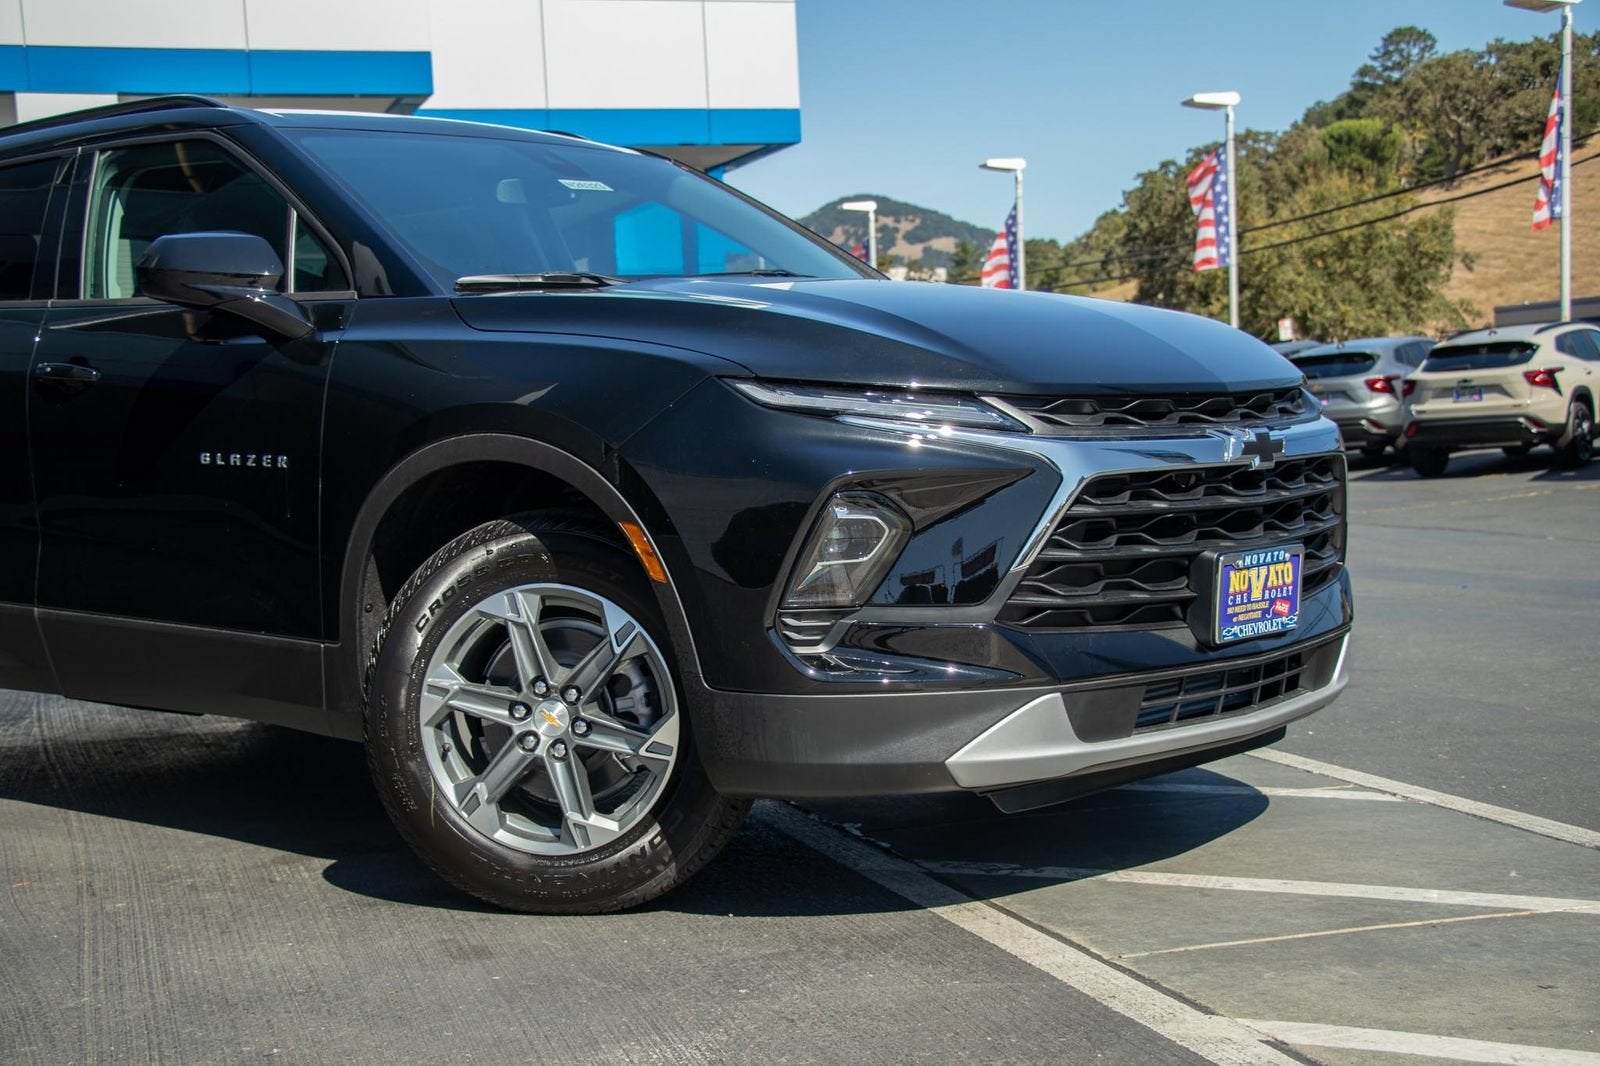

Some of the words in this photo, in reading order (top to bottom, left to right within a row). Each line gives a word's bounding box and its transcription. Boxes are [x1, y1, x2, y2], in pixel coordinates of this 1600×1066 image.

[200, 453, 287, 468] BLAZER
[1244, 550, 1284, 565] NOVATO
[1229, 562, 1293, 600] NOVATO
[1237, 617, 1282, 637] CHEVROLET
